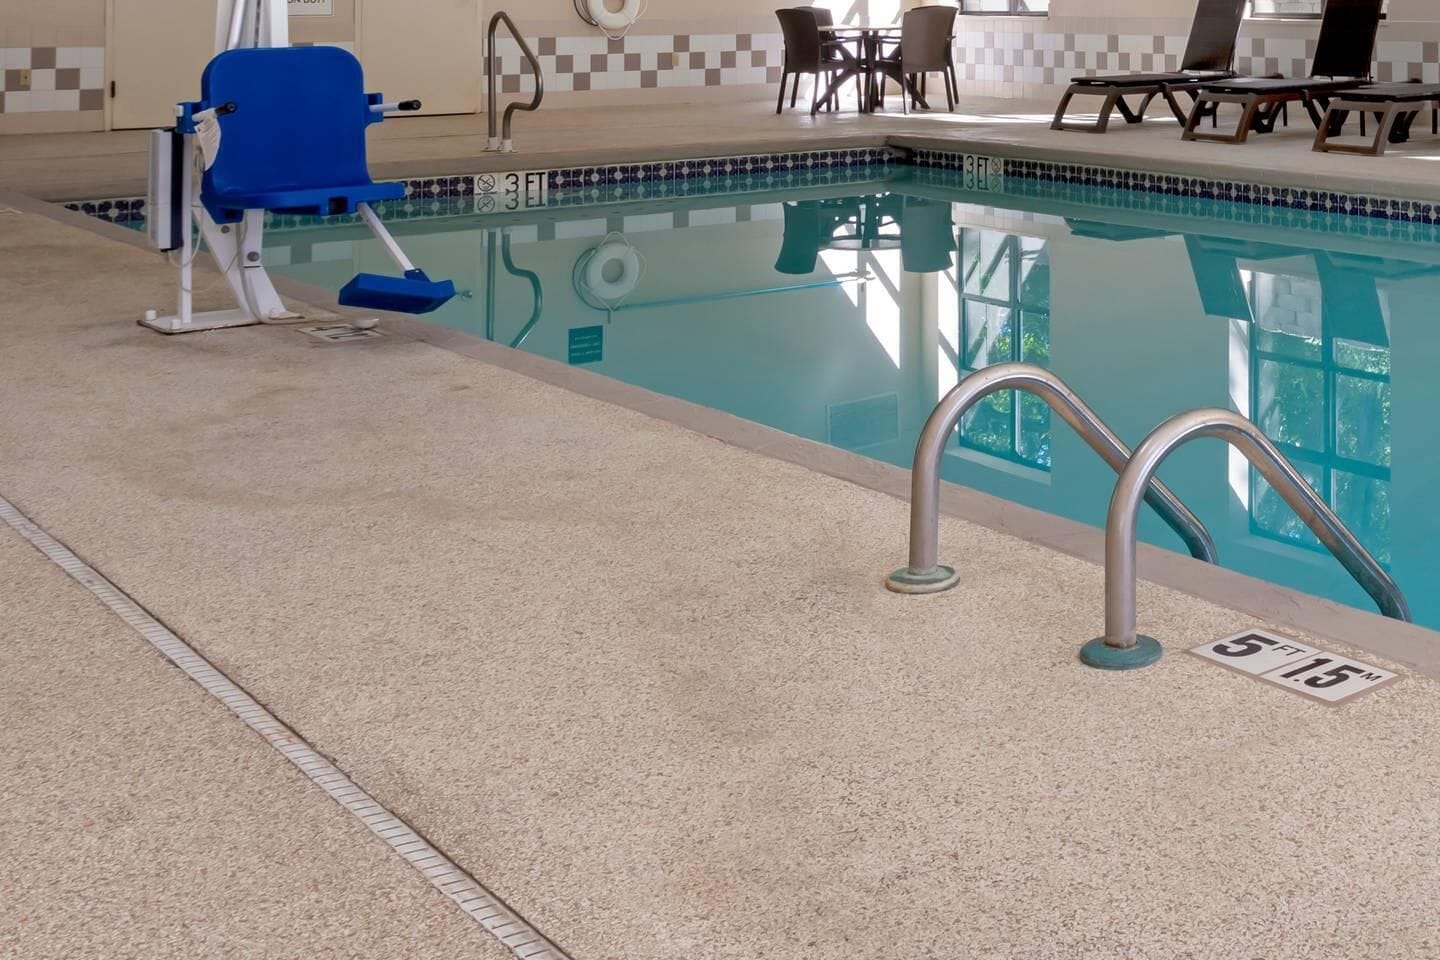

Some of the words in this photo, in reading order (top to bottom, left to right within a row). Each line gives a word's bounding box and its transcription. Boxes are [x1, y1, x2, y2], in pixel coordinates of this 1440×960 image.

[966, 155, 974, 172] 3
[978, 157, 989, 174] FT
[505, 173, 519, 192] 3
[525, 172, 546, 192] FT
[1212, 633, 1280, 657] 5
[1272, 644, 1306, 656] FT
[1280, 658, 1366, 688] 1.5
[1360, 672, 1382, 682] M
